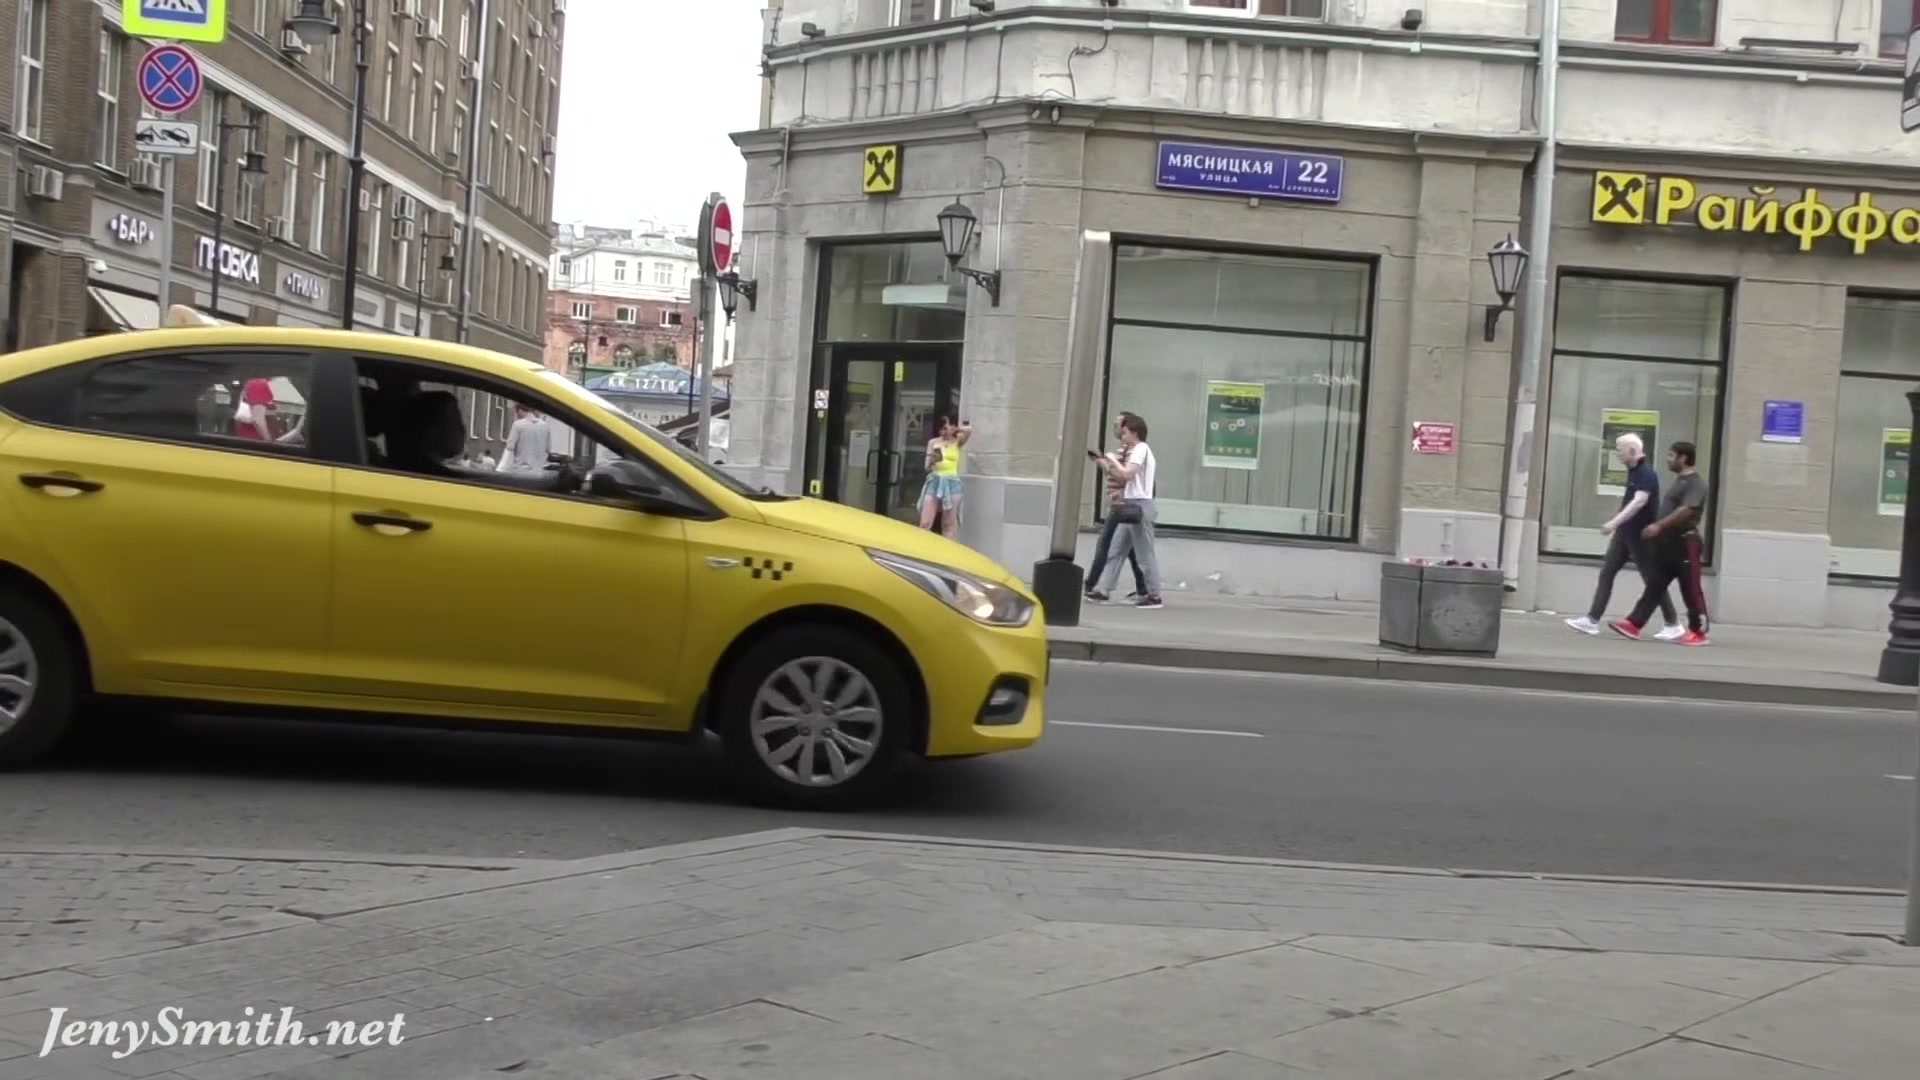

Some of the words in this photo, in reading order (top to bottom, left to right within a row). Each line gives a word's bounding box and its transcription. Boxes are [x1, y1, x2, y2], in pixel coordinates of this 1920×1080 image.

[1168, 153, 1274, 175] МЯСНИЦКАЯ
[1297, 160, 1329, 184] 22
[1199, 173, 1239, 184] УЛИЦА
[118, 214, 148, 243] БАР
[1655, 176, 1920, 255] Райффа
